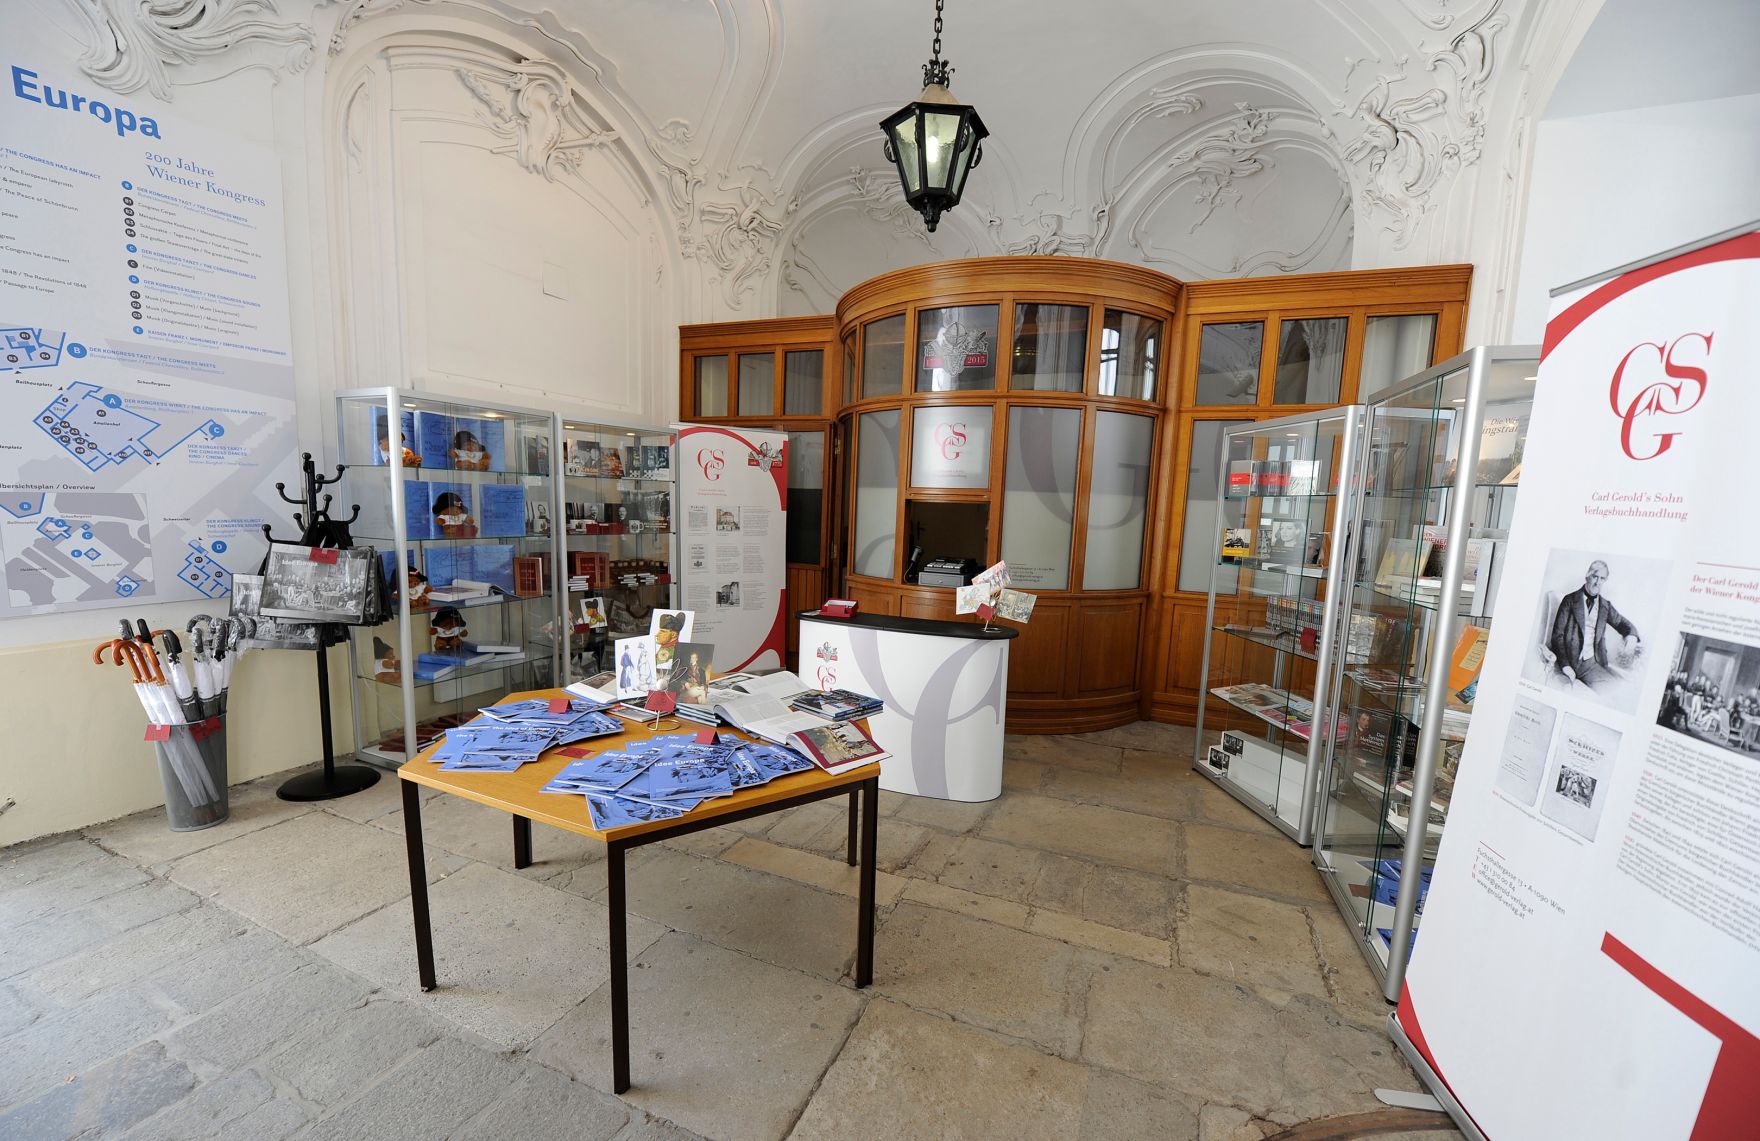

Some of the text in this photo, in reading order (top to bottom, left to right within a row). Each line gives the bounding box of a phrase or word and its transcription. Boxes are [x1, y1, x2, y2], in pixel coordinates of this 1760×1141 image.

[12, 65, 161, 140] Europa
[5, 148, 17, 156] THE
[19, 152, 54, 168] CONGRESS
[55, 162, 68, 171] HAS
[78, 168, 101, 180] IMPACT
[145, 151, 215, 178] 200 Jahre
[9, 166, 19, 174] The
[20, 168, 48, 183] European
[9, 179, 32, 189] emperor
[146, 164, 266, 207] Wiener Kongress
[5, 188, 15, 196] The
[149, 189, 177, 202] KONGRESS
[5, 245, 32, 257] Congress
[52, 255, 70, 264] impact
[153, 251, 182, 262] KONGRESS
[34, 273, 66, 286] Revolutions
[155, 281, 184, 292] KONGRESS
[102, 348, 135, 358] KONGRESS
[169, 358, 198, 366] CONGRESS
[967, 356, 985, 364] 2015
[137, 399, 168, 407] KONGRESS
[1491, 418, 1504, 426] Die
[0, 483, 54, 491] bersichtsplan
[1591, 492, 1684, 504] Carl Gerold's Sohn
[1584, 506, 1688, 522] Verlagsbuchhandlung
[1693, 574, 1759, 591] Der Carl Gerold
[1690, 585, 1703, 593] der
[1706, 587, 1734, 599] Wiener
[686, 743, 714, 751] Europa
[675, 758, 705, 767] Europa
[1550, 899, 1566, 915] Wien
